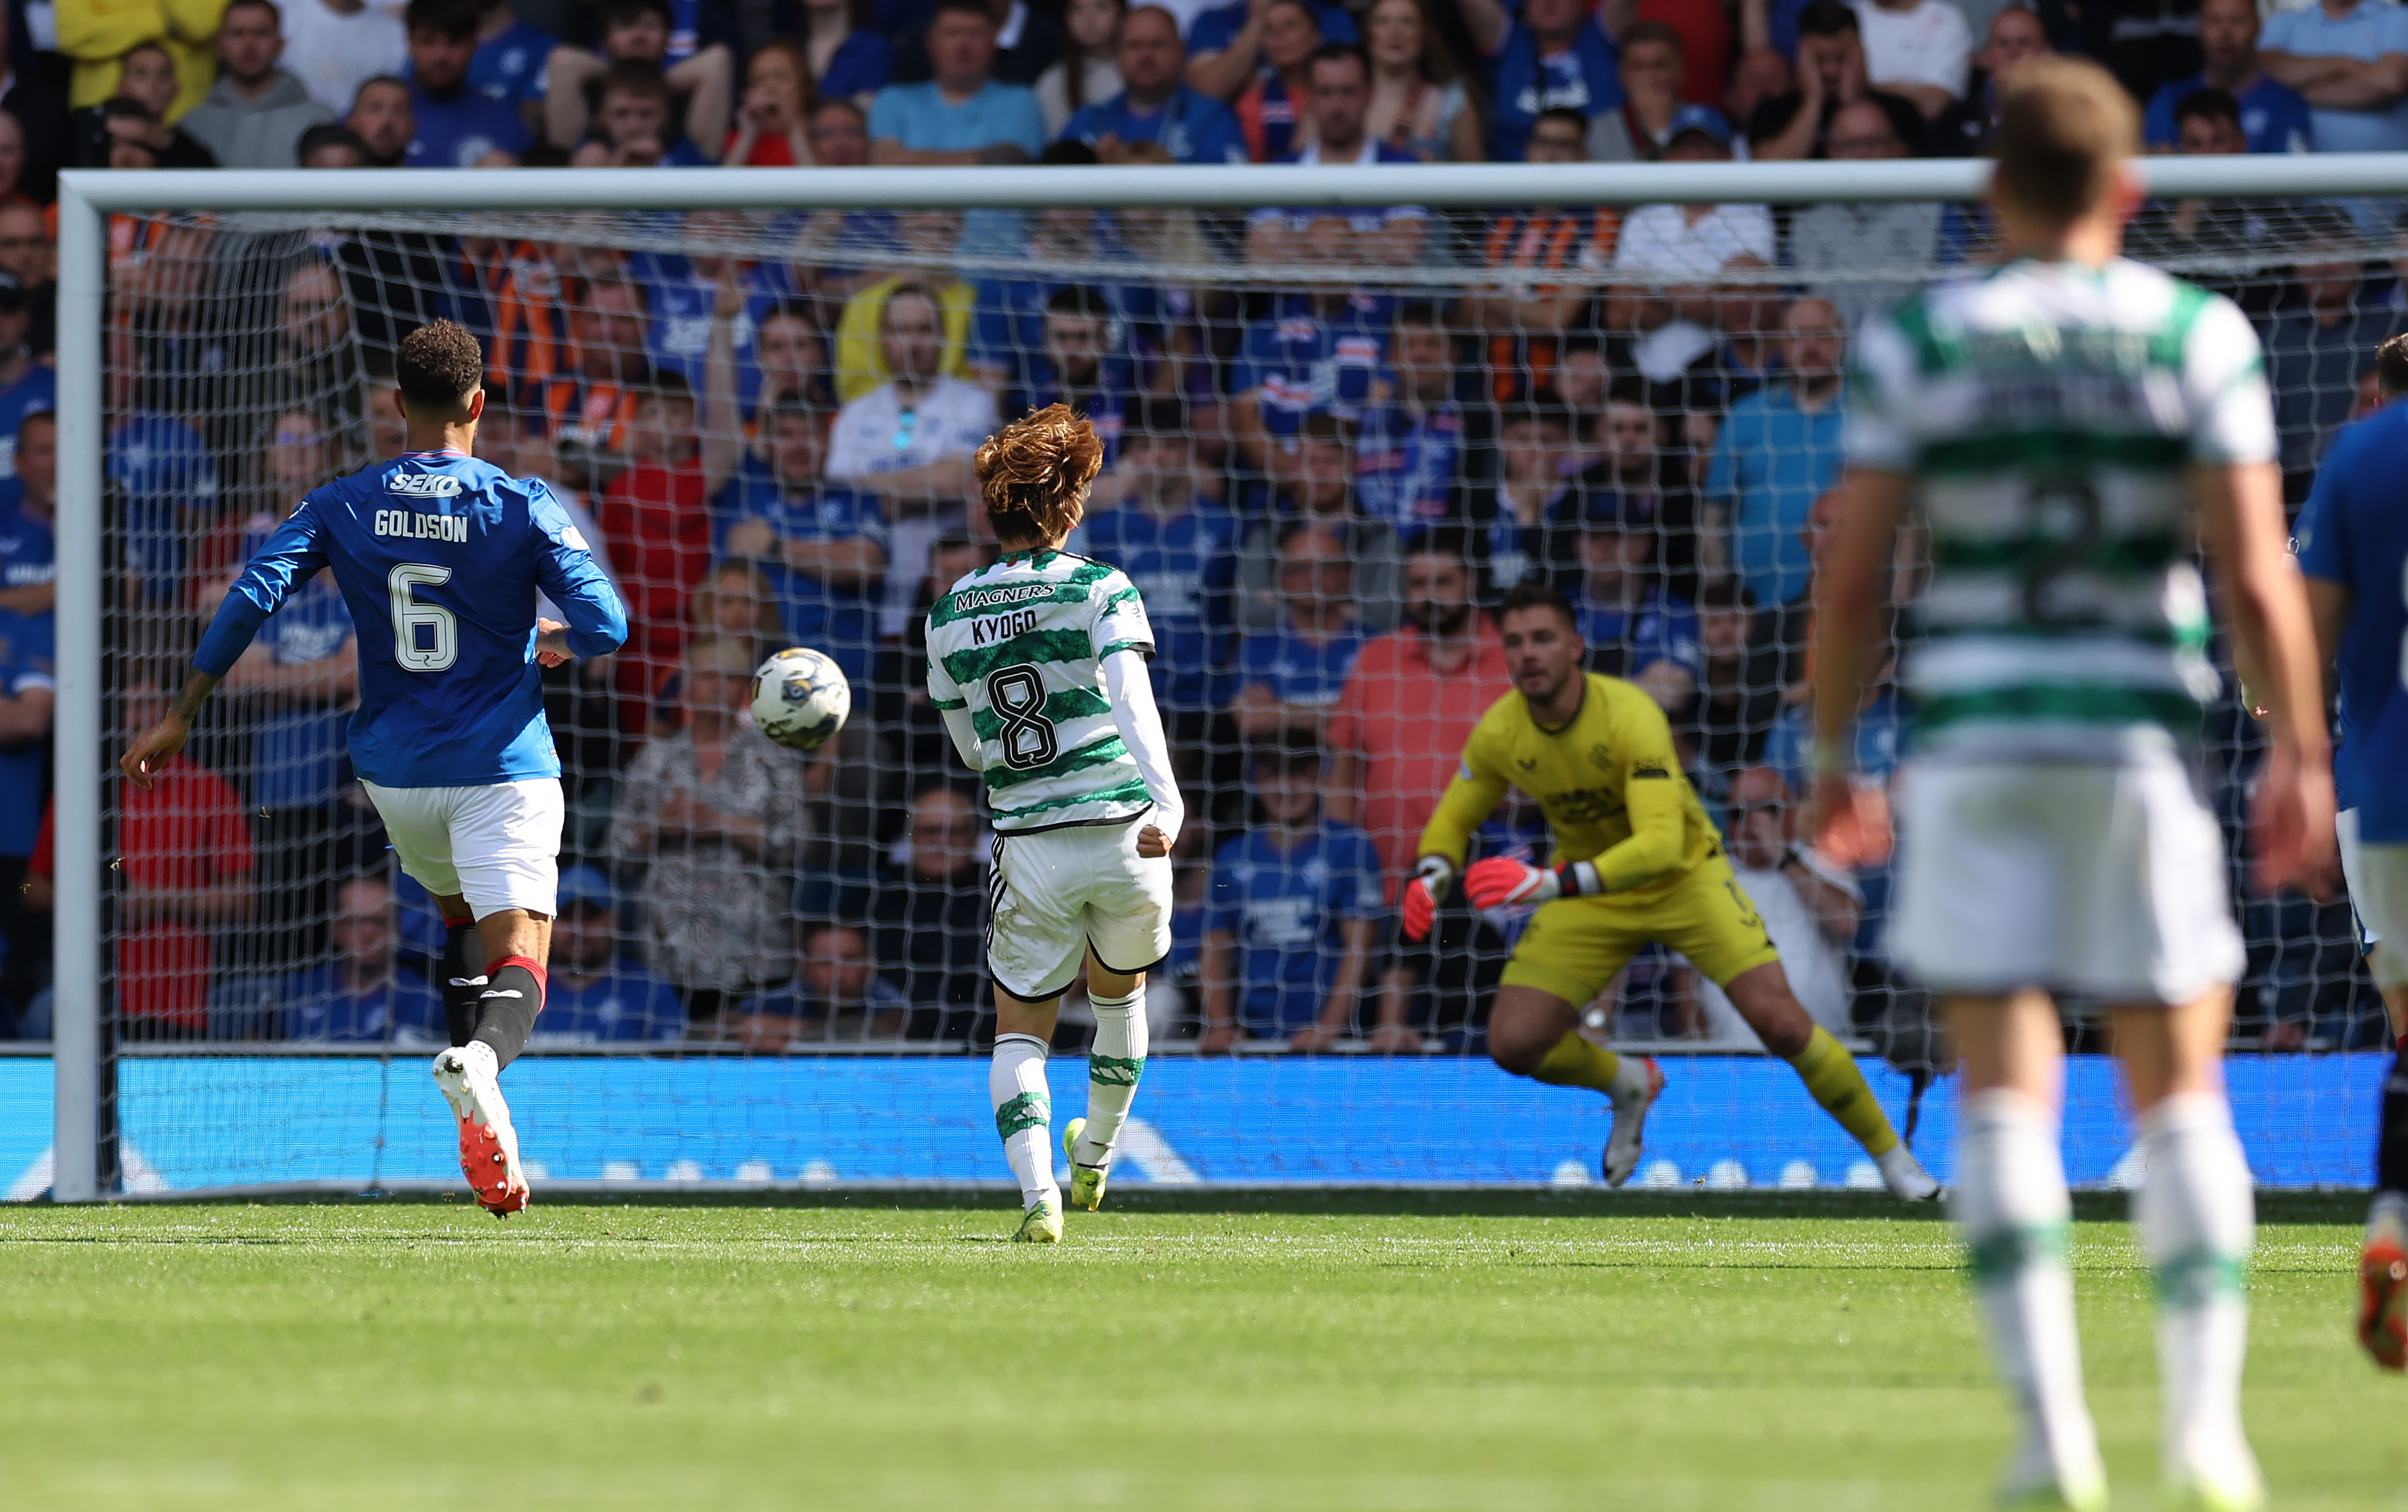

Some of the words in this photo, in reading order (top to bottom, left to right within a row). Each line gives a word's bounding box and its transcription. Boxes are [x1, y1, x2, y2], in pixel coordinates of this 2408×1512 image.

[389, 473, 462, 495] SEKO
[374, 510, 468, 543] GOLDSON
[2024, 476, 2105, 628] 2
[954, 583, 1057, 613] MAGNERS
[388, 562, 458, 672] 6
[971, 609, 1037, 645] KYOGO
[986, 663, 1060, 771] 8
